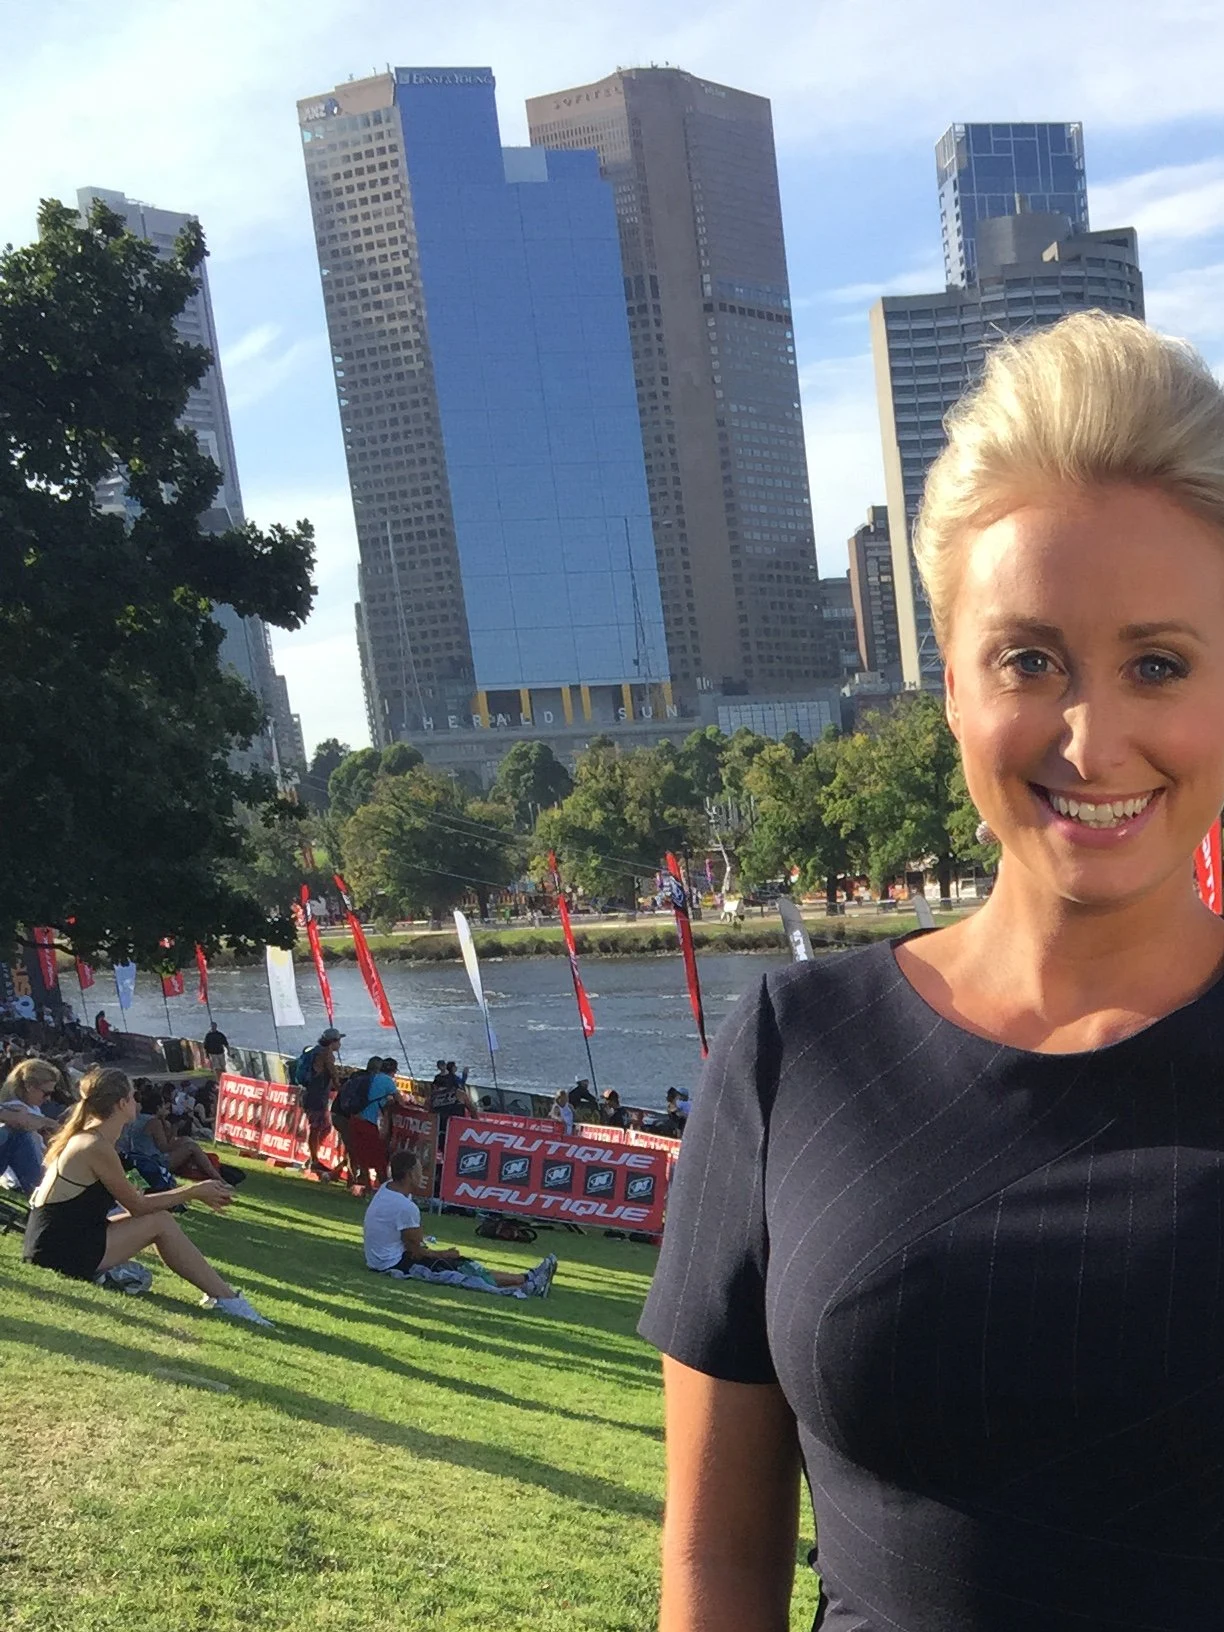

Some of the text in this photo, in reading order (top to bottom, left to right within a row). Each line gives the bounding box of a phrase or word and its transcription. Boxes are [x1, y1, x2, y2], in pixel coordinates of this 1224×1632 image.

[422, 705, 678, 730] HERALD SUN
[459, 1128, 656, 1169] NAUTIQUE
[455, 1182, 652, 1222] NAUTIQUE
